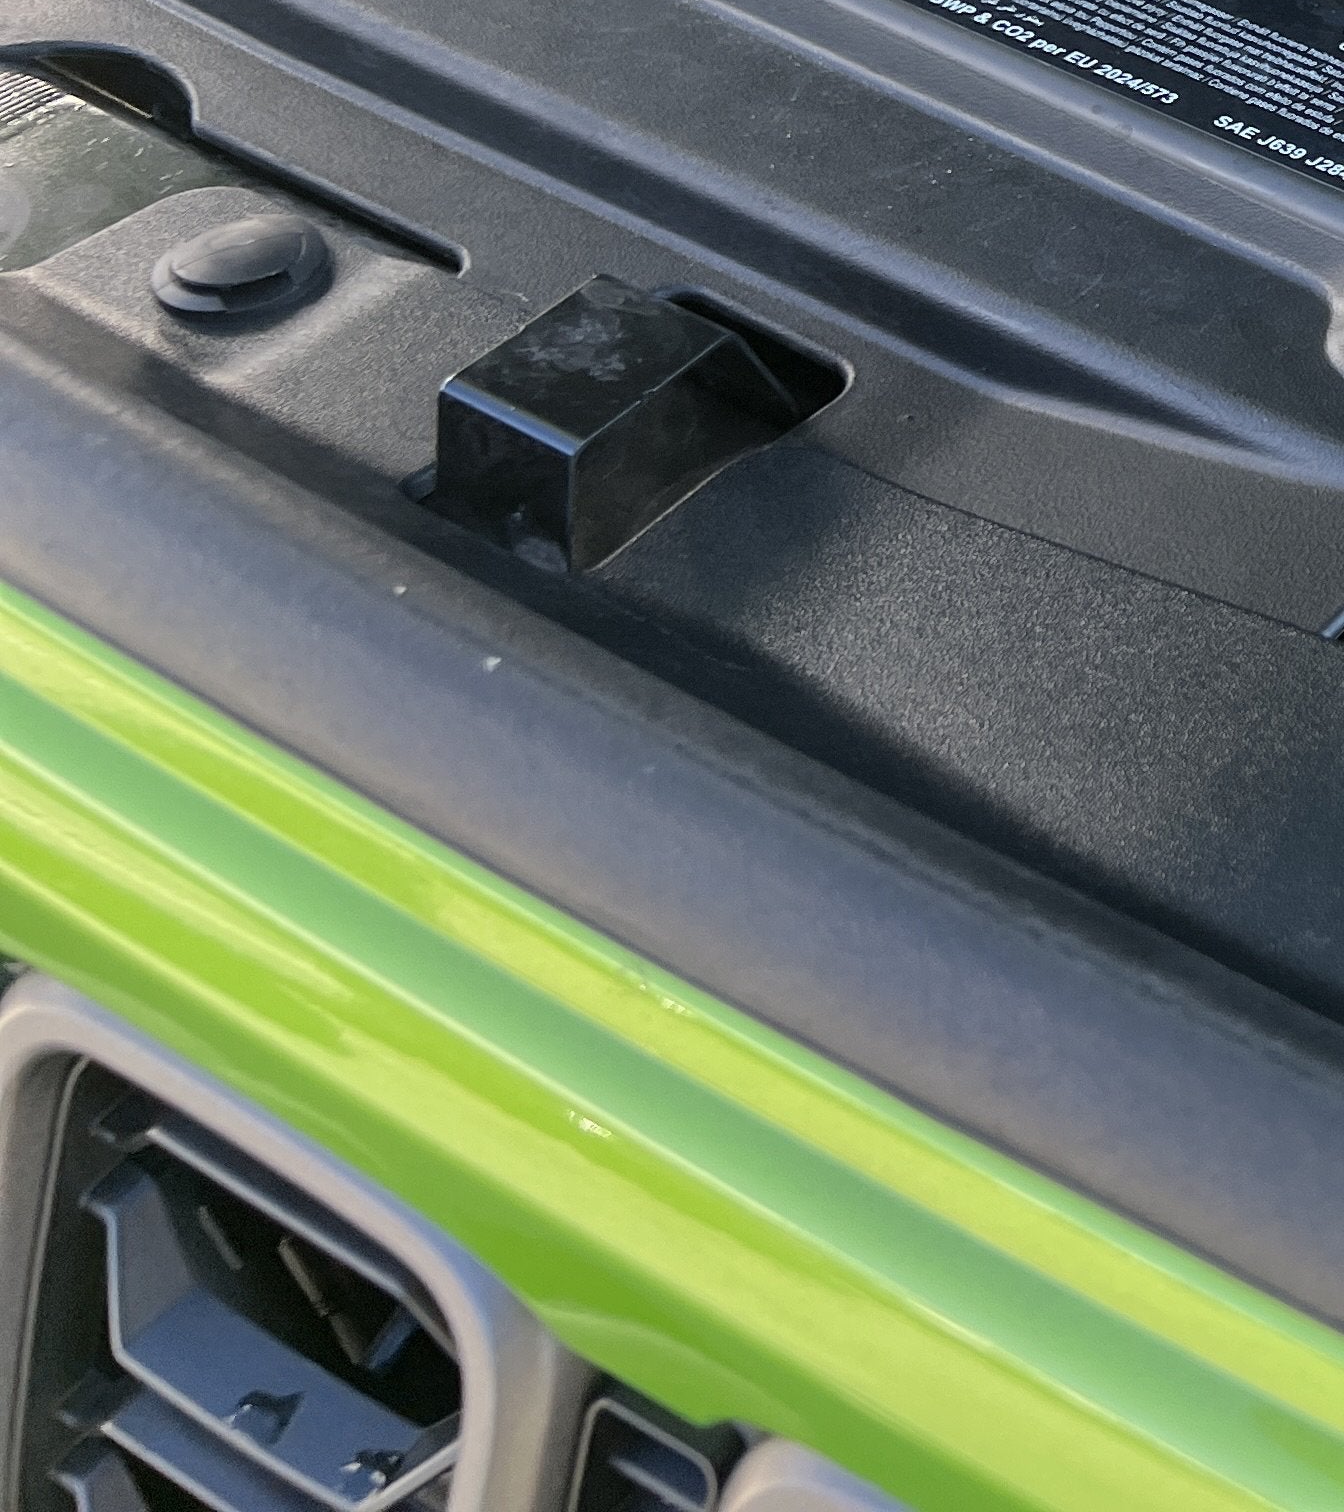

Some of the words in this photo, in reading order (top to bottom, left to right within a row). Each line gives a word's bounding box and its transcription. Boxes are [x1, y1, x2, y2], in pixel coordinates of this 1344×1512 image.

[973, 12, 992, 24] &
[991, 19, 1035, 42] CO2
[1027, 38, 1066, 55] per
[1063, 50, 1098, 68] EU
[1092, 64, 1178, 103] 2024/573
[1213, 115, 1260, 139] SAE
[1256, 135, 1306, 159] J639
